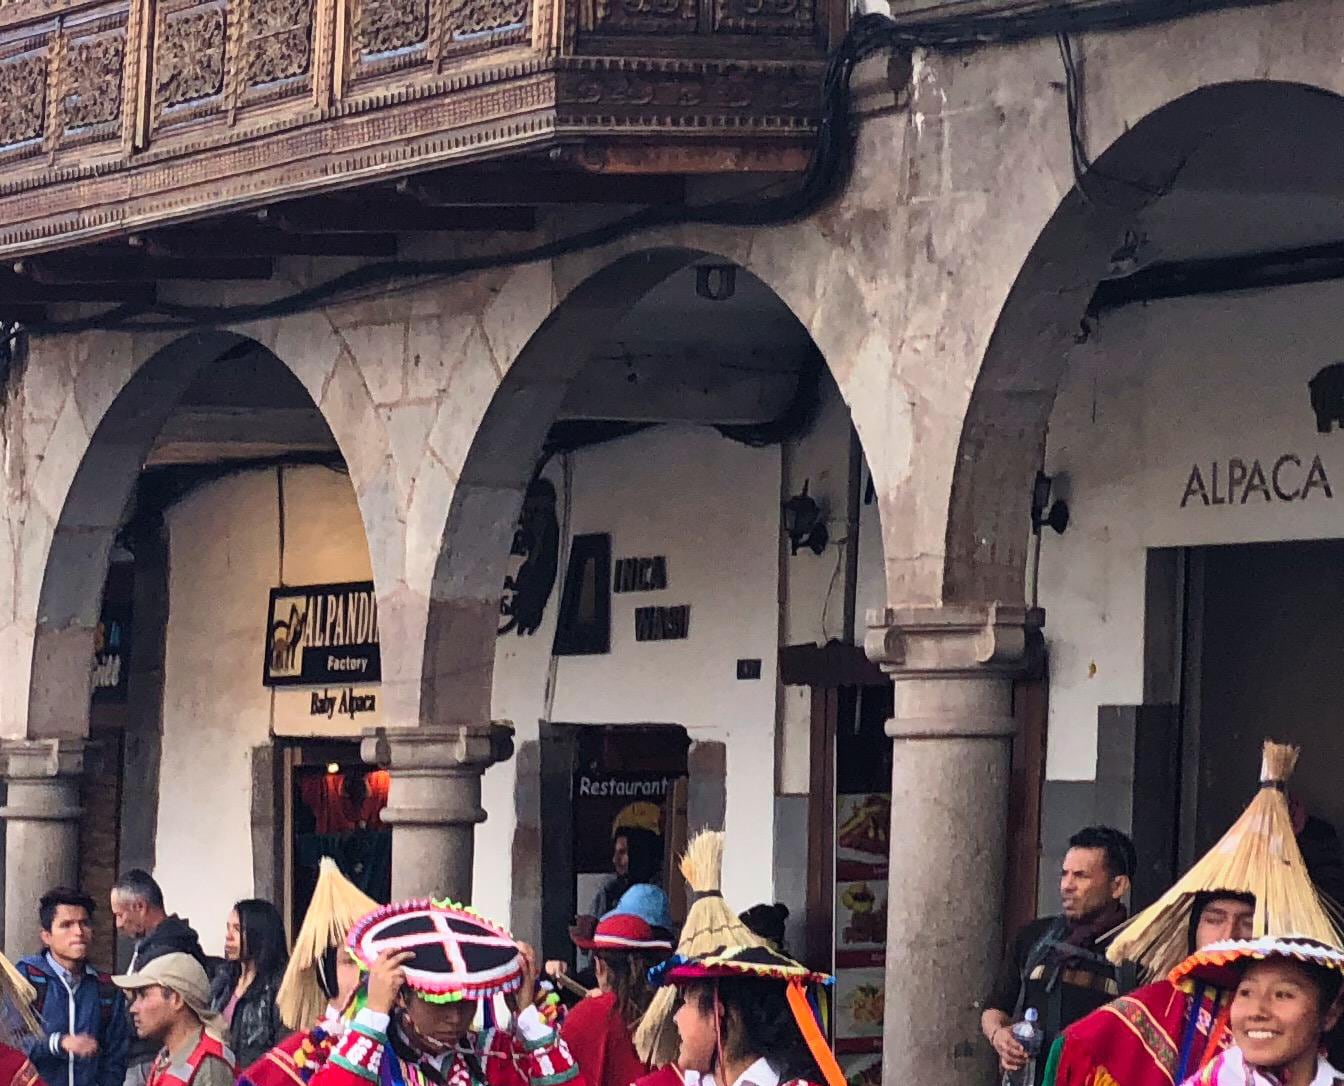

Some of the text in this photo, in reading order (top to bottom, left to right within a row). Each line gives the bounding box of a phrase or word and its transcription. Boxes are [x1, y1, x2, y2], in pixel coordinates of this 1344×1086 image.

[1180, 453, 1333, 508] ALPACA
[304, 591, 379, 648] ALPANDI
[327, 656, 368, 672] Factory
[311, 688, 376, 720] Baby Alpaca
[580, 776, 667, 796] Restaurant
